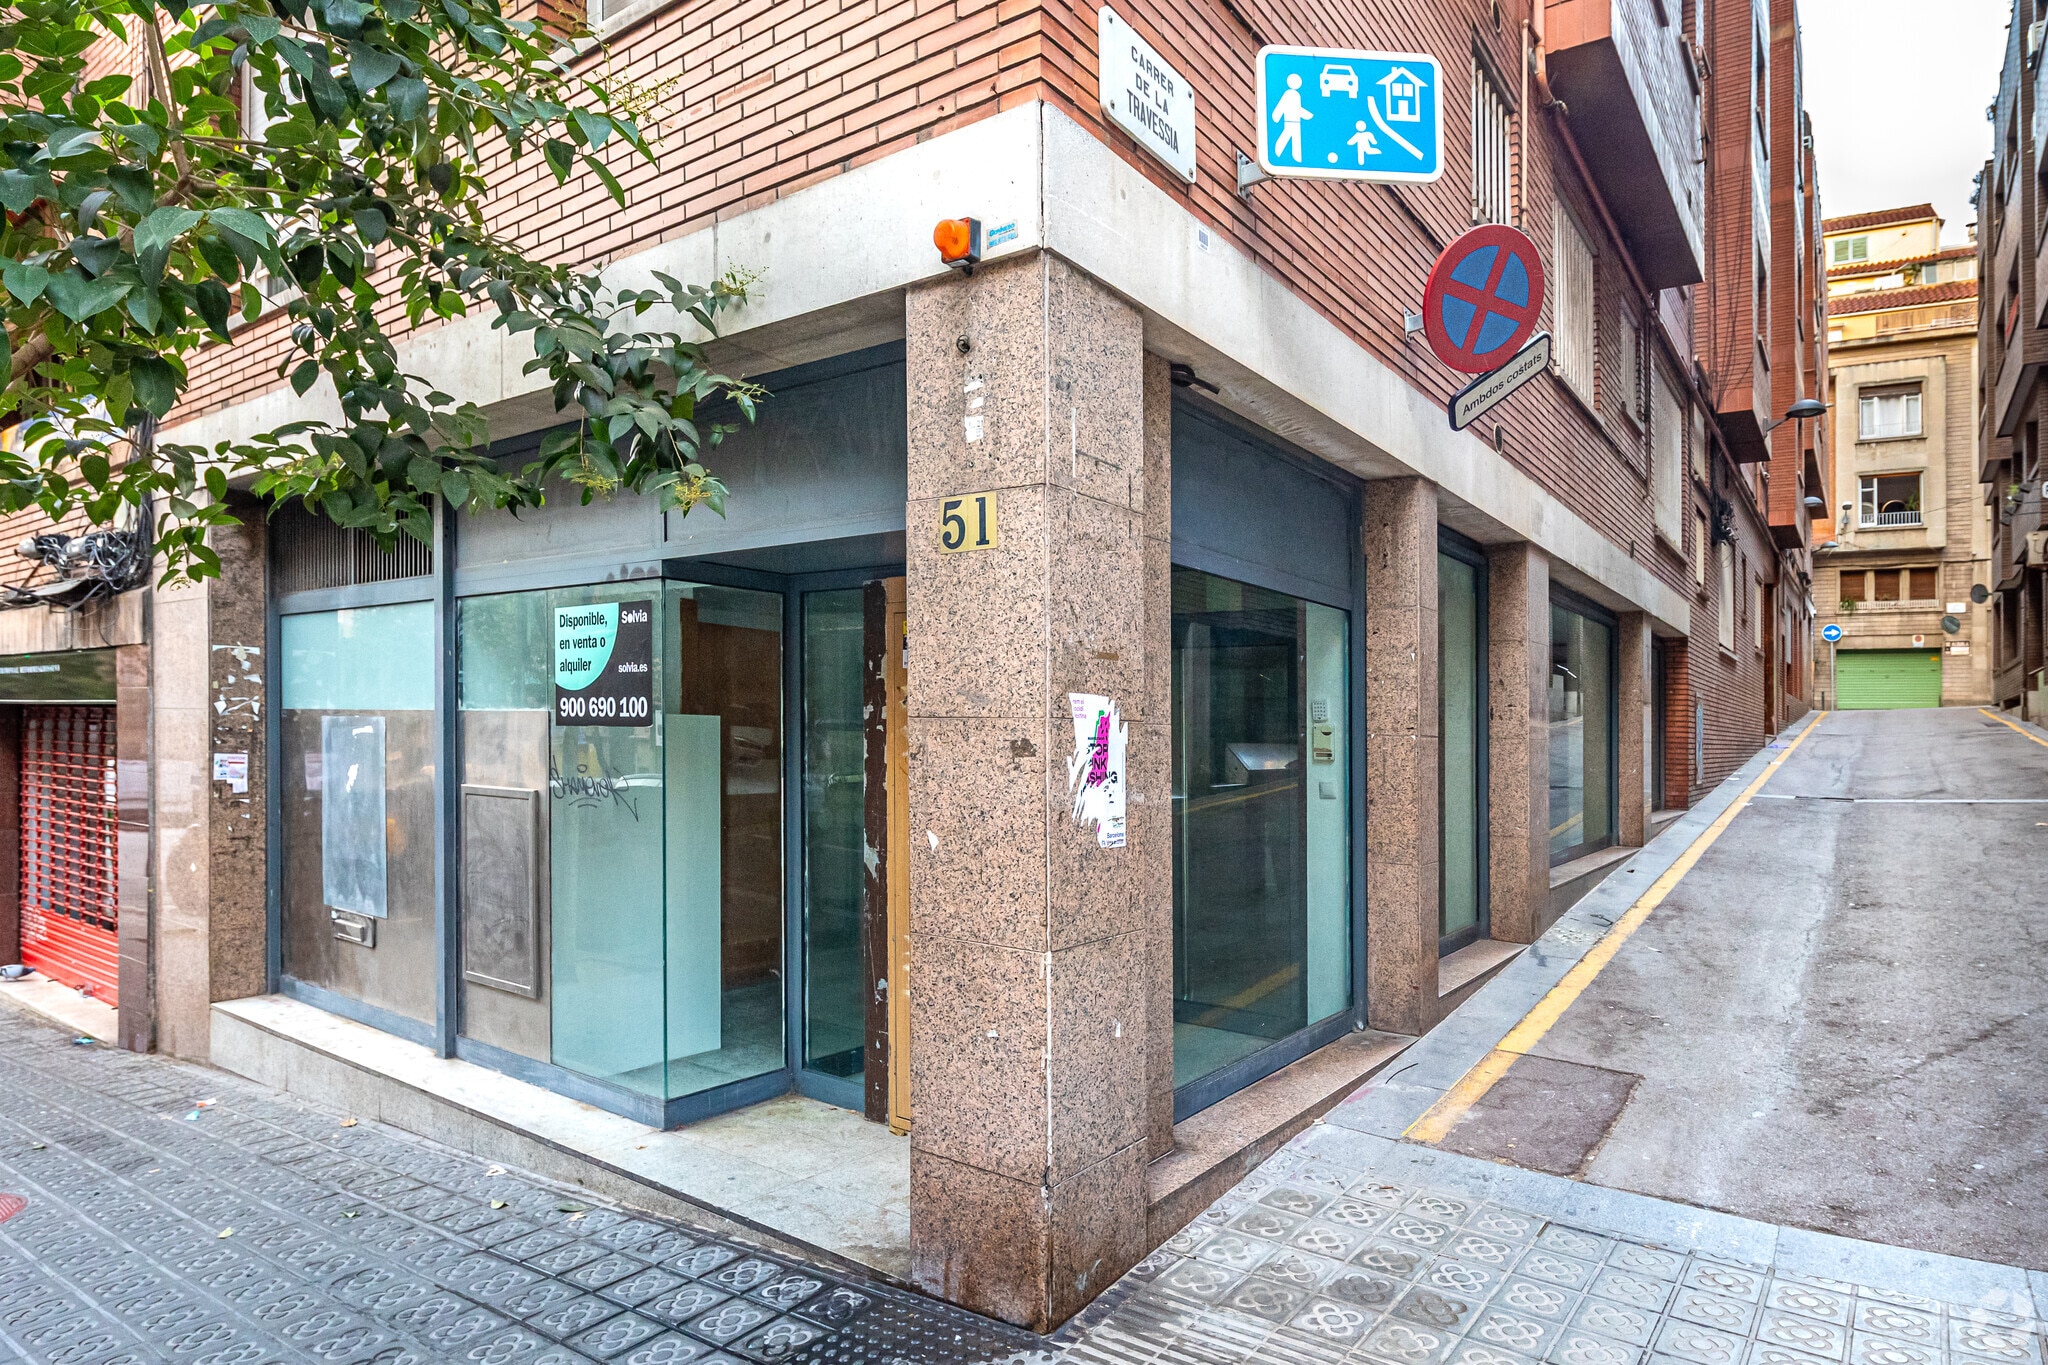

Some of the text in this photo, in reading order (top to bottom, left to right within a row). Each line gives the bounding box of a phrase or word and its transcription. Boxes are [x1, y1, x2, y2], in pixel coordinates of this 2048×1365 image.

[1131, 45, 1174, 98] CARRER
[1135, 72, 1169, 115] DE LA
[1126, 88, 1179, 154] TRAVESSIA
[1462, 352, 1542, 416] Ambdos costats
[942, 496, 990, 550] 51
[559, 611, 608, 630] Disponible,
[621, 609, 648, 624] Solvia
[559, 635, 606, 650] en venta o
[559, 657, 592, 675] alquiler
[618, 661, 648, 673] solvia.es
[560, 696, 648, 718] 900 690 100
[1088, 757, 1108, 771] INK
